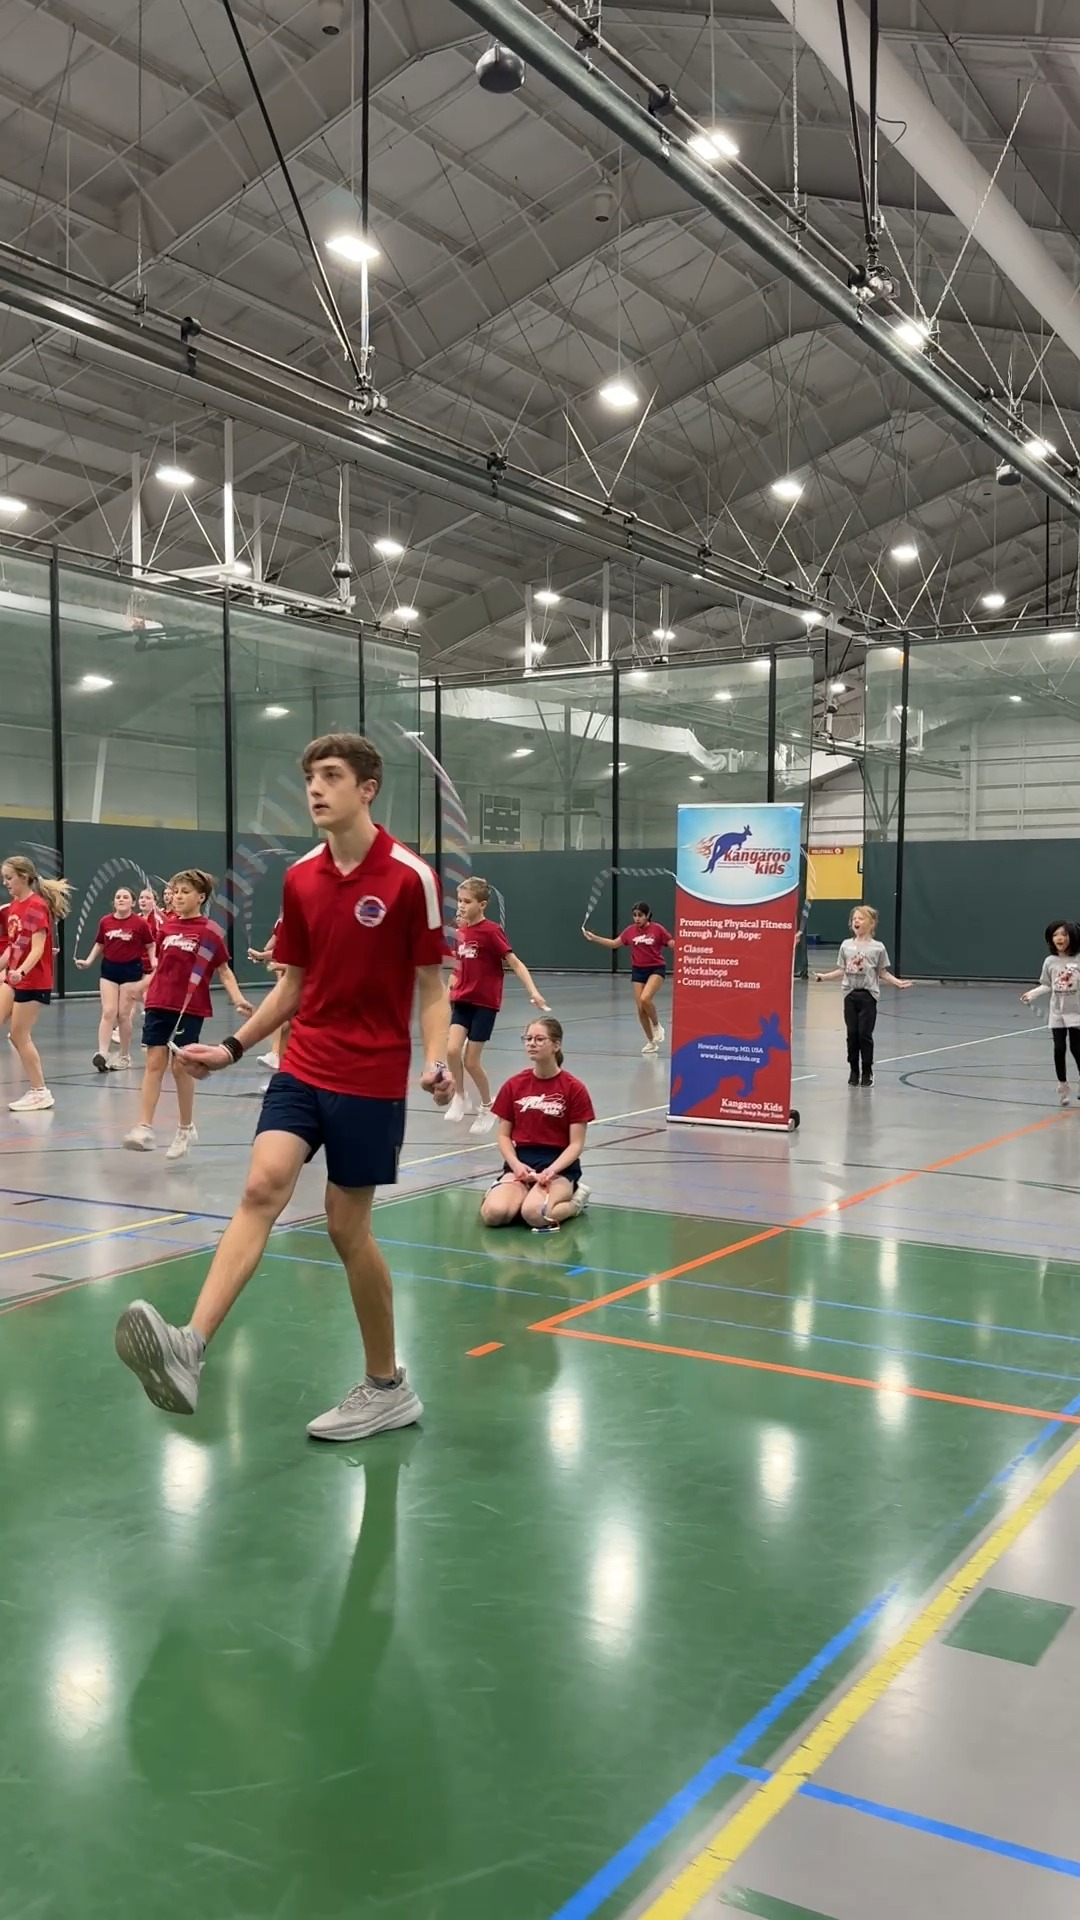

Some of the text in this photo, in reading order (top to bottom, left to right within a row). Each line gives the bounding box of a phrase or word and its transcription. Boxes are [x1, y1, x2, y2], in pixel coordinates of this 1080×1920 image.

[724, 850, 791, 864] Kangaroo
[755, 862, 785, 874] kids
[679, 918, 792, 930] Promoting Physical Fitness
[679, 929, 761, 941] through Jump Rope:
[683, 944, 714, 954] Classes
[683, 955, 739, 966] Performances
[683, 966, 728, 977] Workshops
[682, 978, 760, 989] Competition Teams
[700, 1052, 760, 1063] www.kangarookids.org
[721, 1098, 783, 1112] Kangaroo Kids
